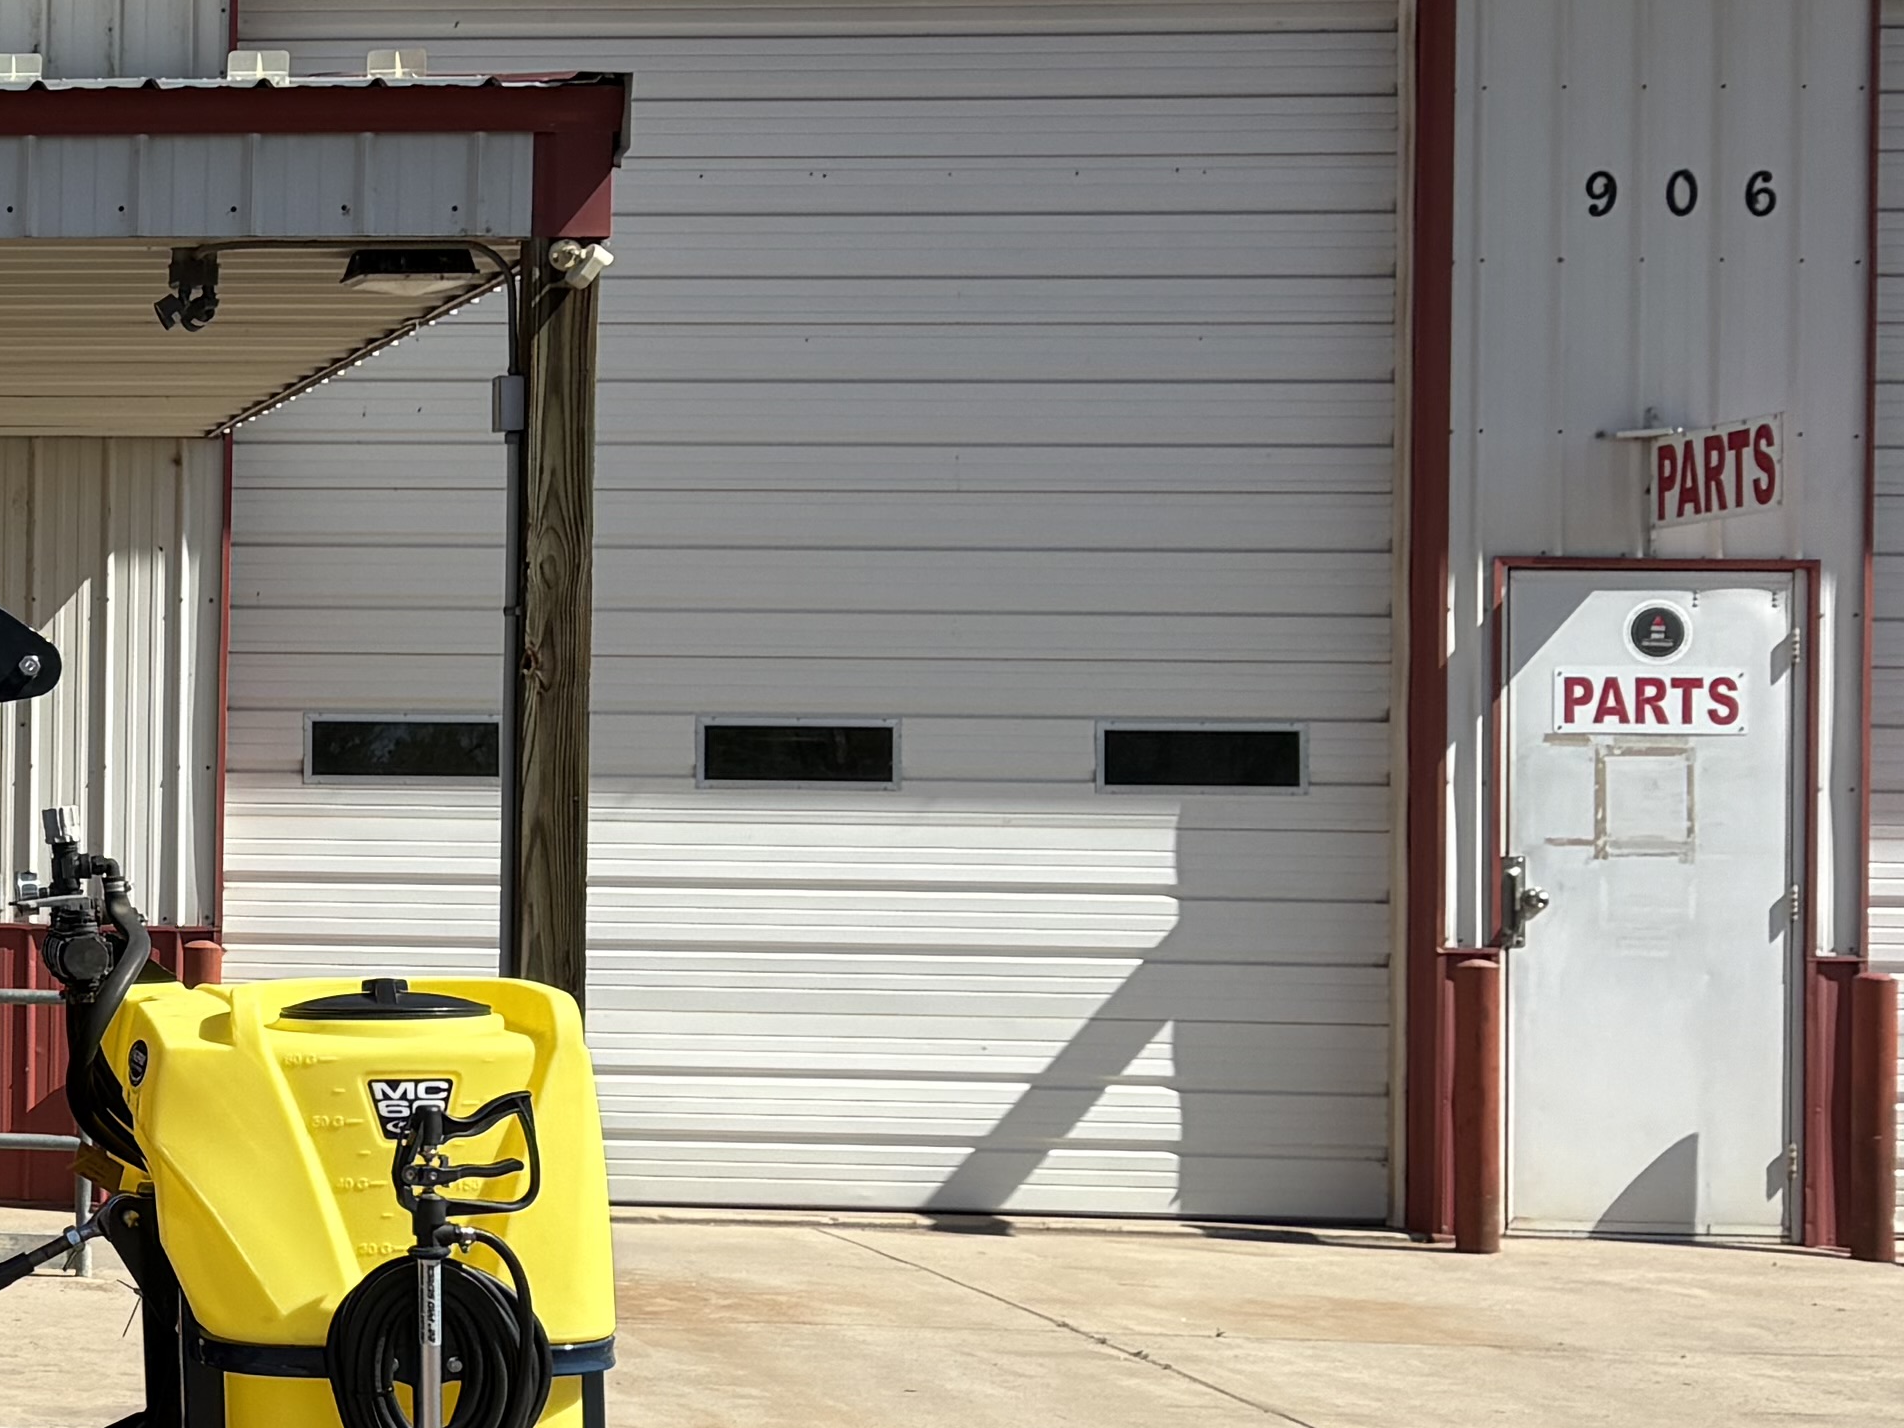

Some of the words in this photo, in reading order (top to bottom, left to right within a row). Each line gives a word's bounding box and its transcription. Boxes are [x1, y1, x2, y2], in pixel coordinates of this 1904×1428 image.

[1657, 423, 1777, 522] PARTS
[1563, 676, 1739, 726] PARTS
[371, 1080, 449, 1100] MC
